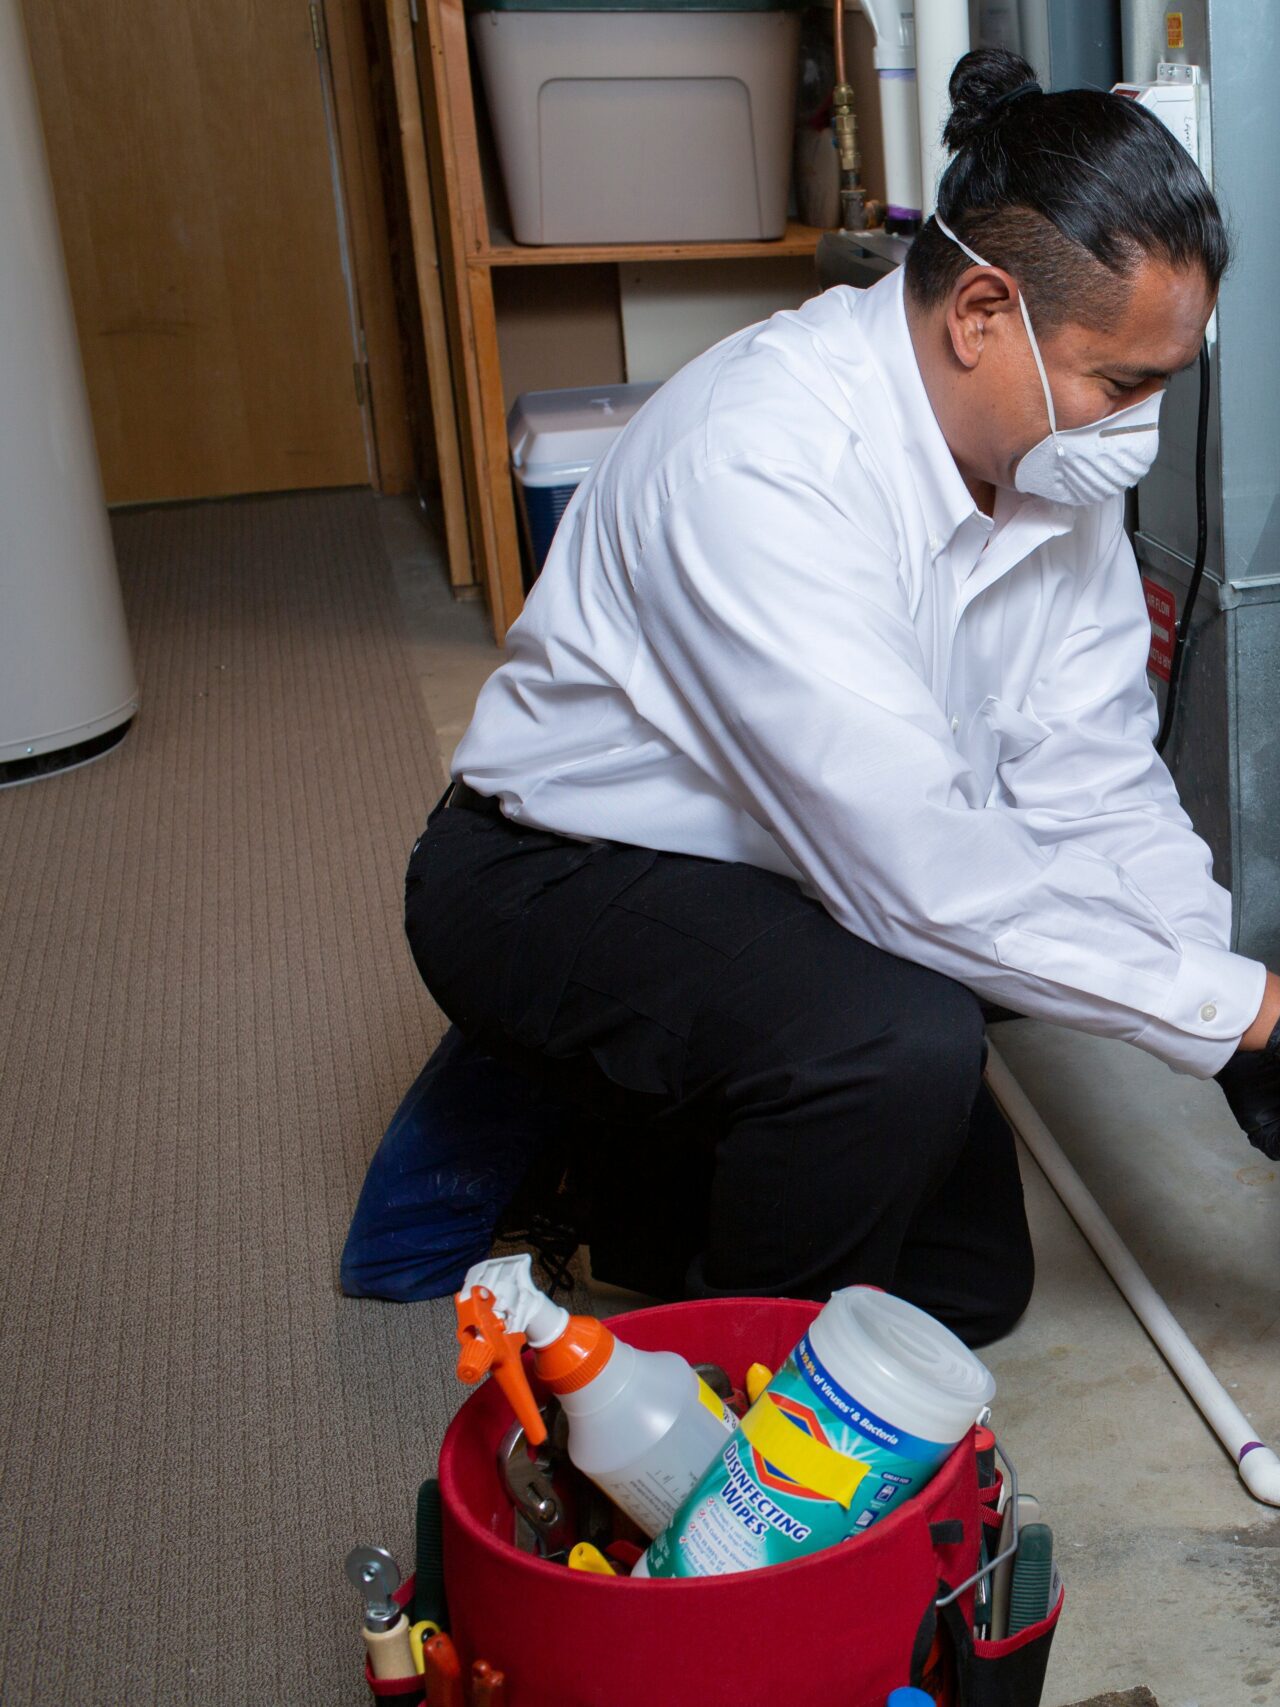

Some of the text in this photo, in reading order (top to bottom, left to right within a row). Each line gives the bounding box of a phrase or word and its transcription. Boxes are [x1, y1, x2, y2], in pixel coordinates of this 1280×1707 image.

[814, 1375, 824, 1385] of
[851, 1412, 860, 1422] &
[860, 1418, 899, 1445] Bacteria
[725, 1442, 809, 1540] DISINFECTING
